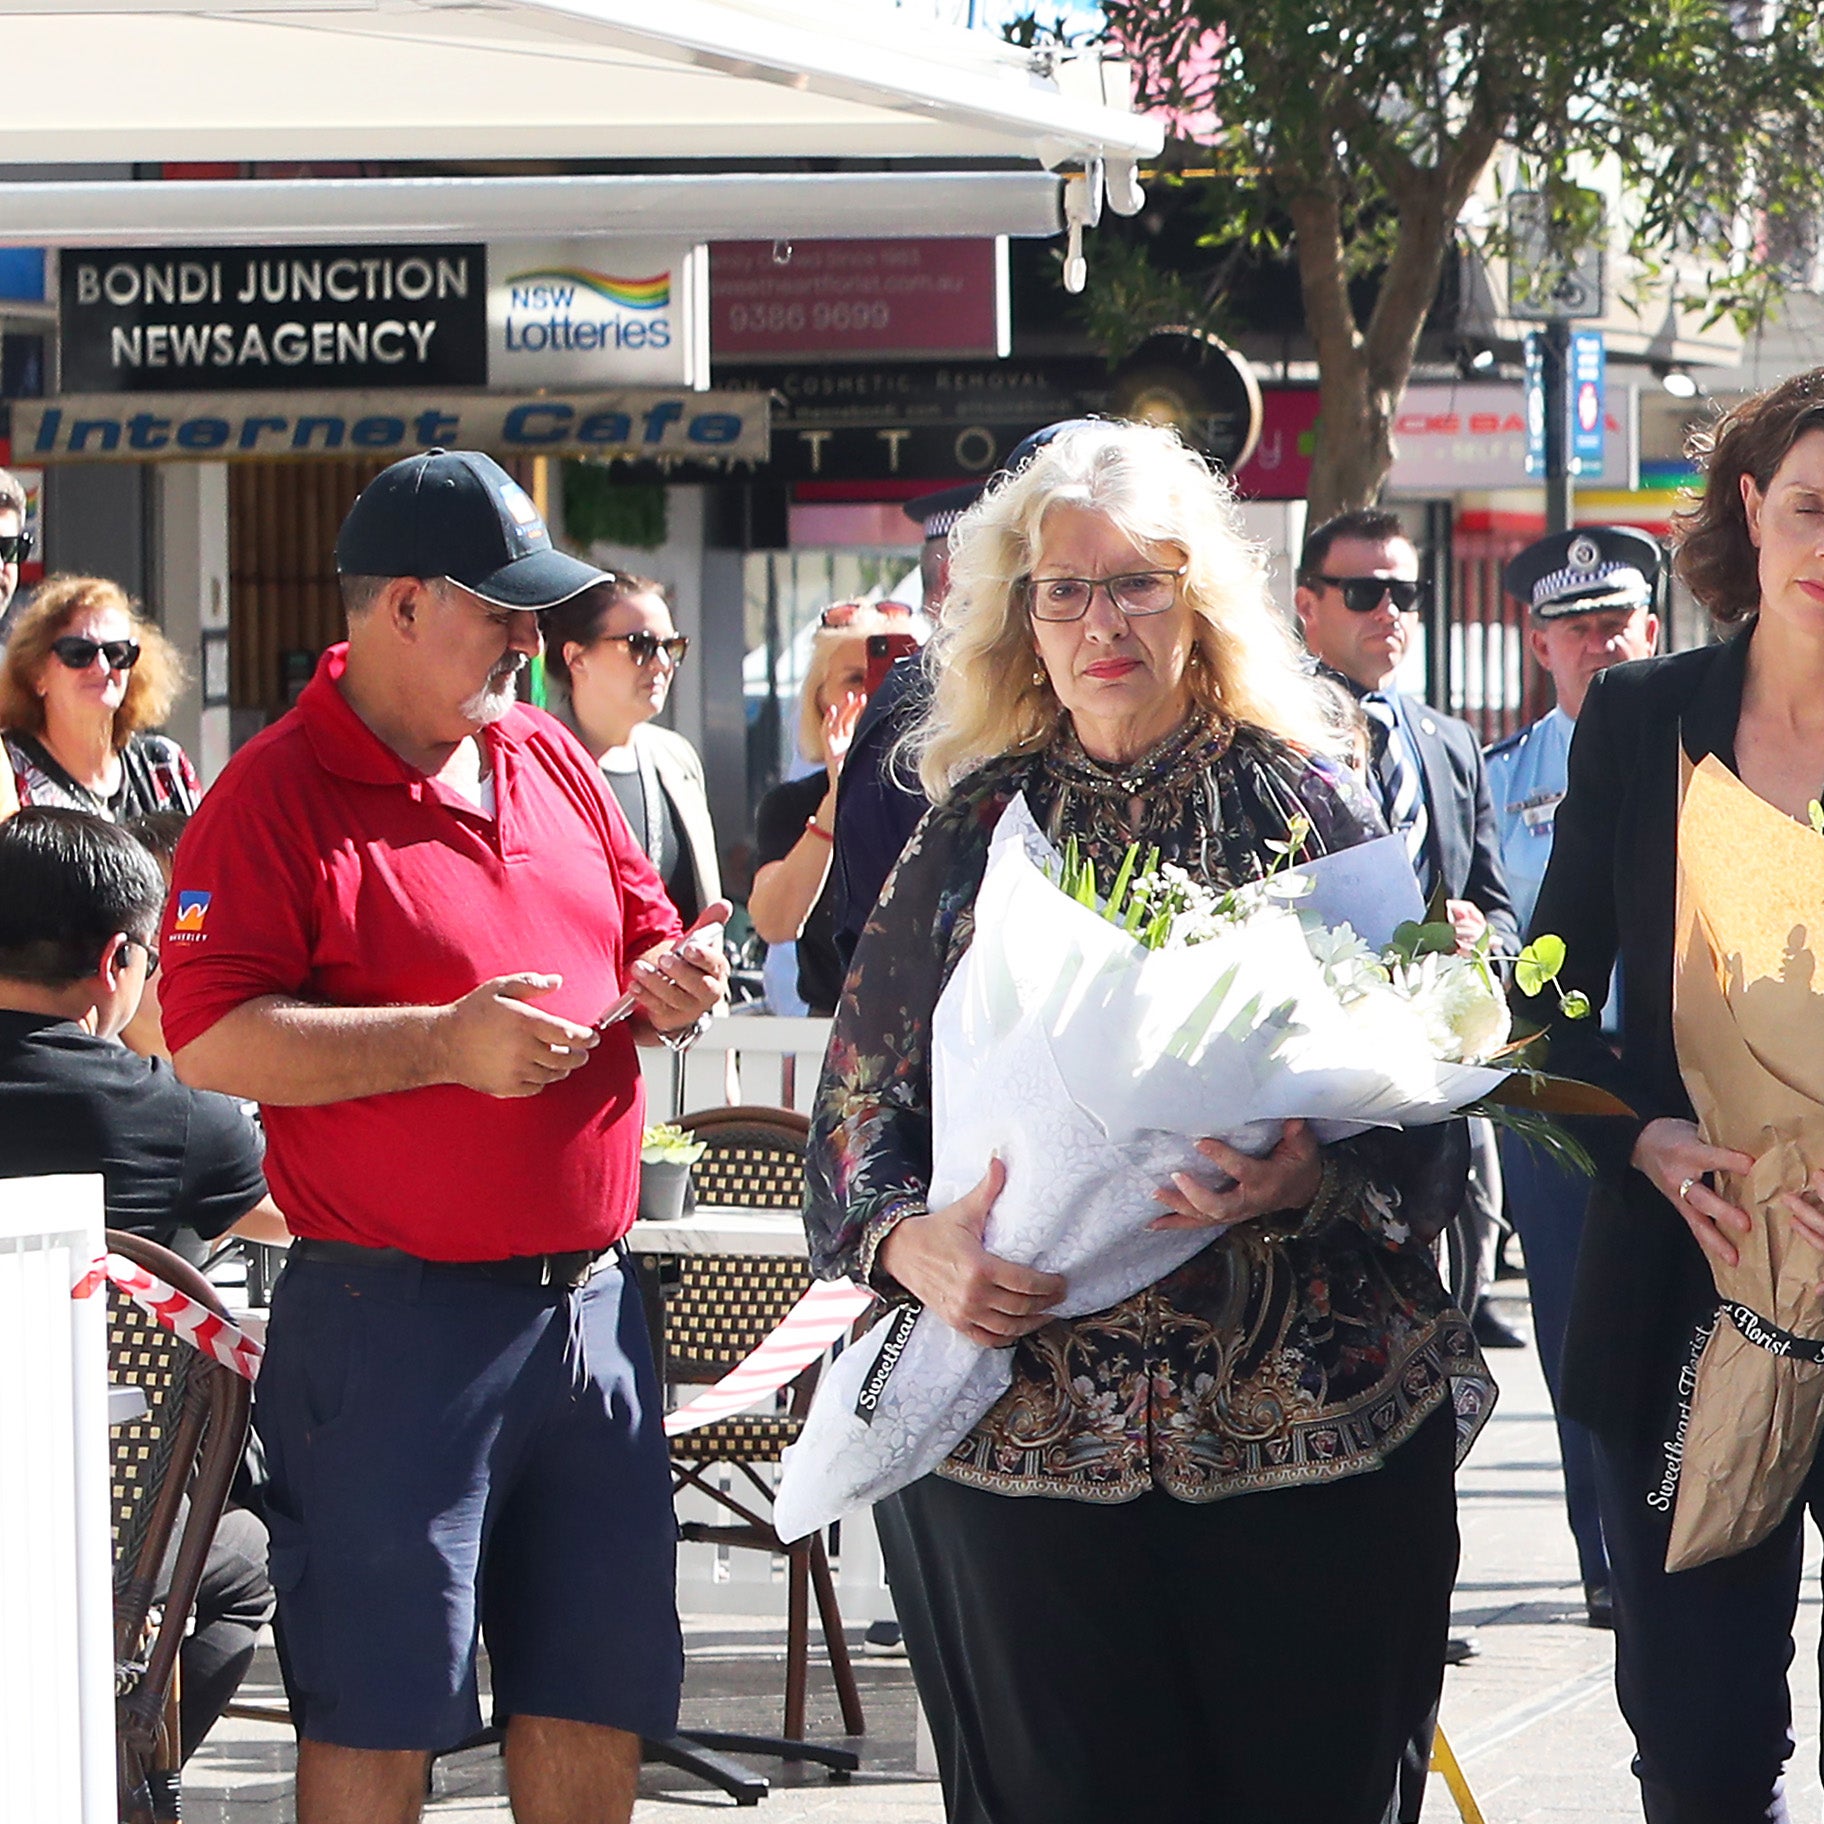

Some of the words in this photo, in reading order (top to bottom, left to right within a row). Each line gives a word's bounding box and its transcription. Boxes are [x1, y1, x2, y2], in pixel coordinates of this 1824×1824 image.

[77, 262, 221, 306] BONDI
[237, 257, 468, 304] JUNCTION
[512, 285, 575, 309] NSW
[506, 313, 671, 352] Lotteries
[729, 303, 805, 333] 9386
[812, 301, 890, 330] 9699
[111, 320, 437, 368] NEWSAGENCY
[34, 408, 459, 453] Internet
[502, 401, 742, 444] Cafe
[1734, 1306, 1792, 1356] Florist
[860, 1303, 921, 1411] Sweetheart
[1647, 1400, 1692, 1512] Sweetheart
[1678, 1325, 1711, 1397] Florist
